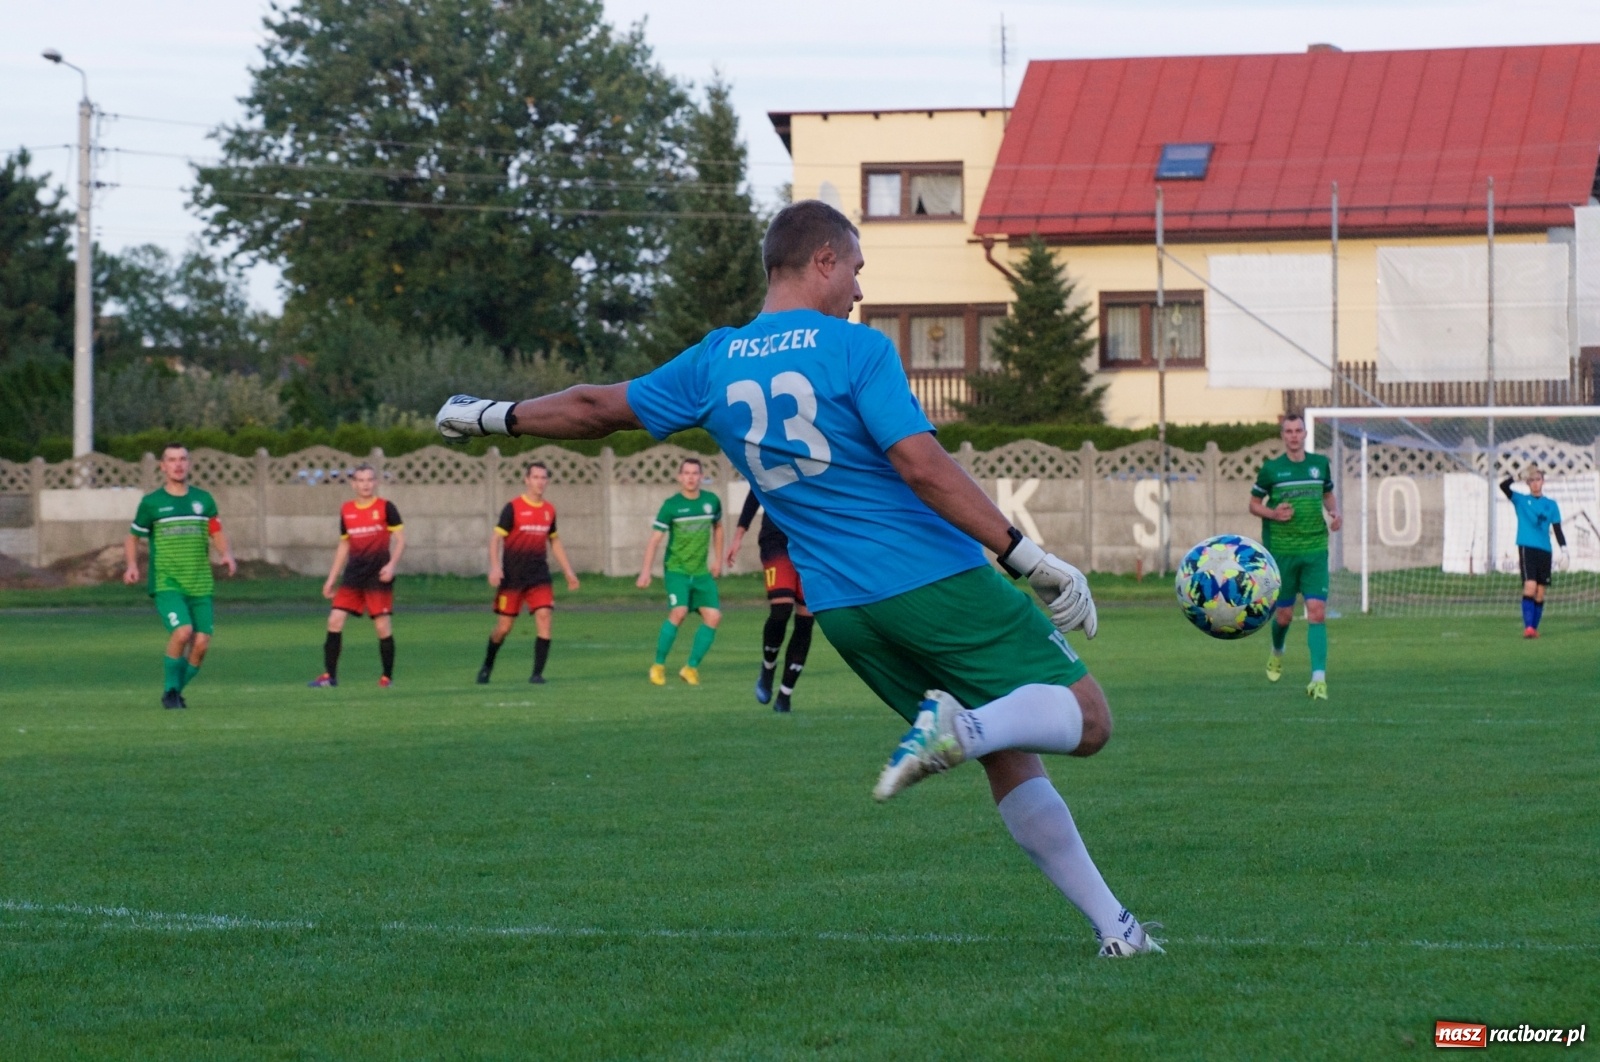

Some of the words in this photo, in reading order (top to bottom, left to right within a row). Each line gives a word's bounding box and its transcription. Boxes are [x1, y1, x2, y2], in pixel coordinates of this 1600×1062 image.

[728, 328, 819, 358] PISZCZEK
[726, 370, 832, 493] 23
[996, 478, 1045, 545] K
[1132, 479, 1170, 549] S
[167, 611, 180, 627] 2
